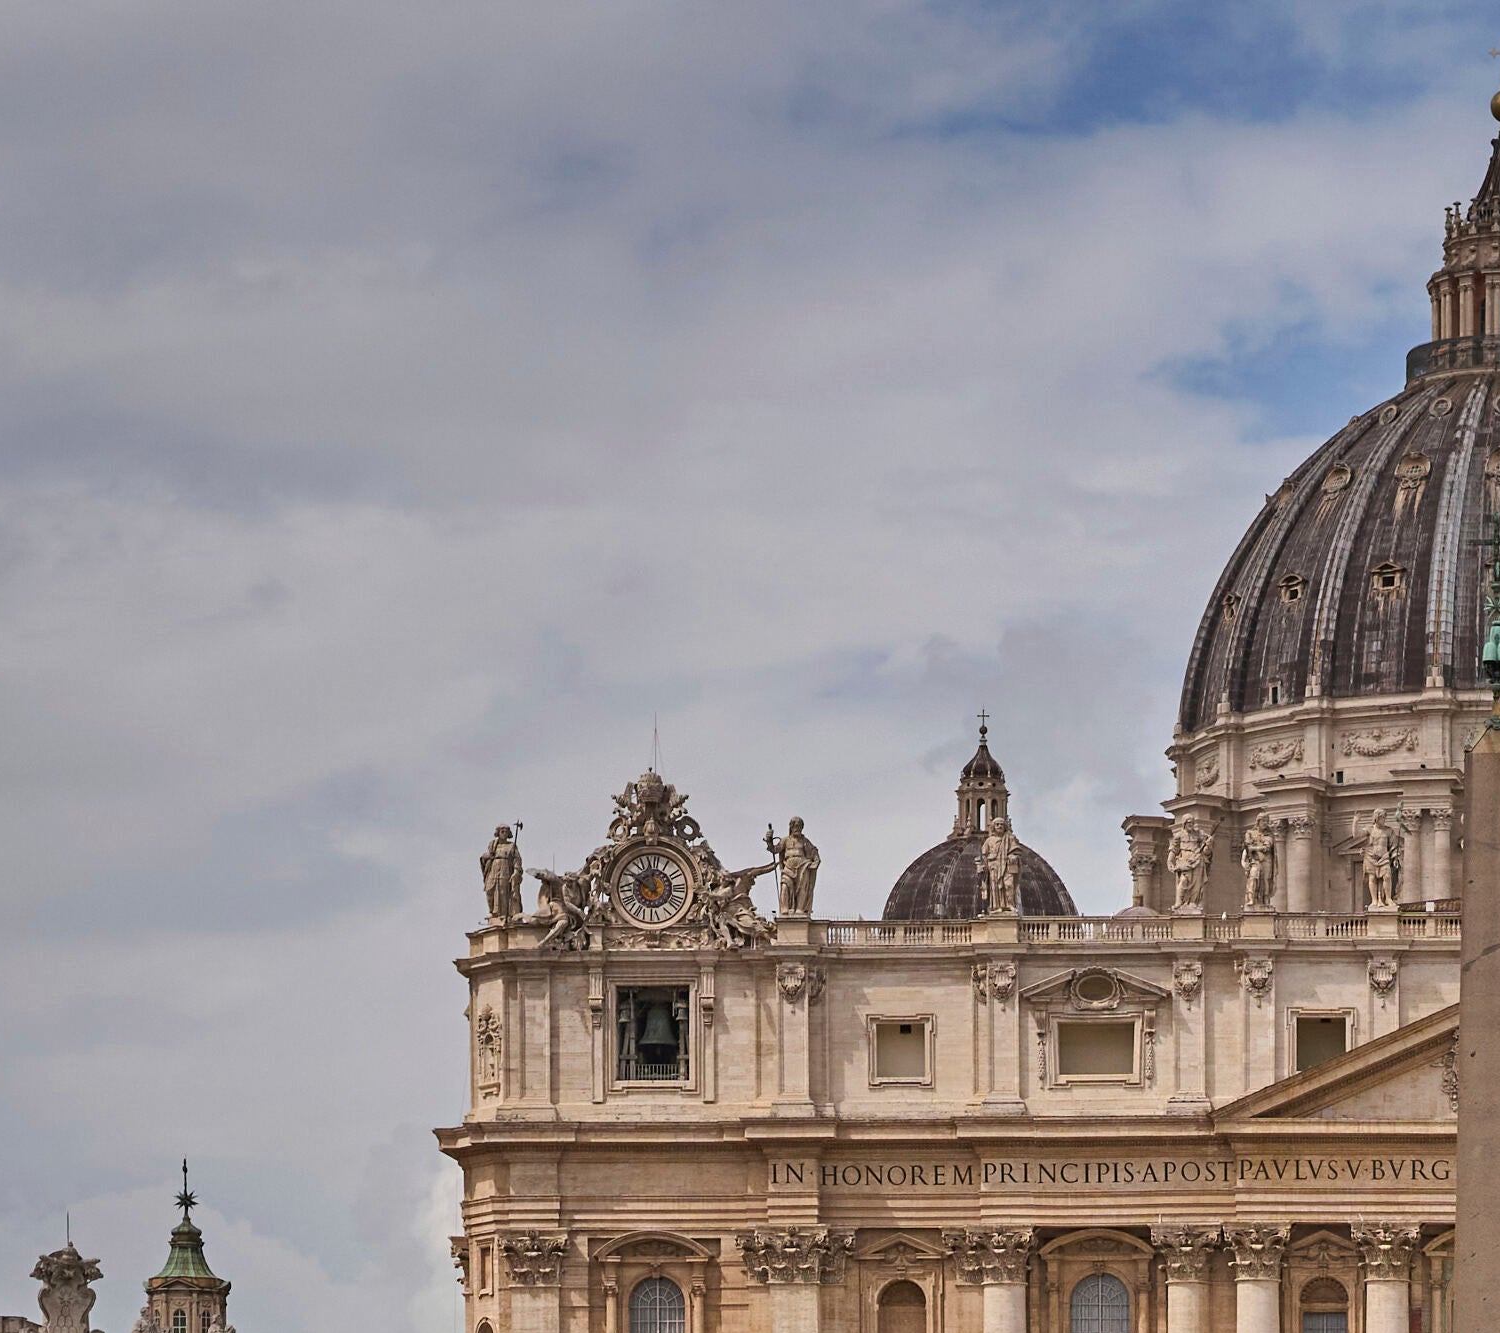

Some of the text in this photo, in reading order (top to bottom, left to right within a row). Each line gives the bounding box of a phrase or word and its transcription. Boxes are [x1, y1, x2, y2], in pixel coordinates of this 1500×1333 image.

[771, 1163, 804, 1184] IN
[821, 1164, 974, 1185] HONOREM
[983, 1162, 1134, 1184] PRINCIPIS
[1142, 1161, 1234, 1182] APOST
[1239, 1159, 1338, 1180] PAVLVS
[1347, 1159, 1363, 1180] V
